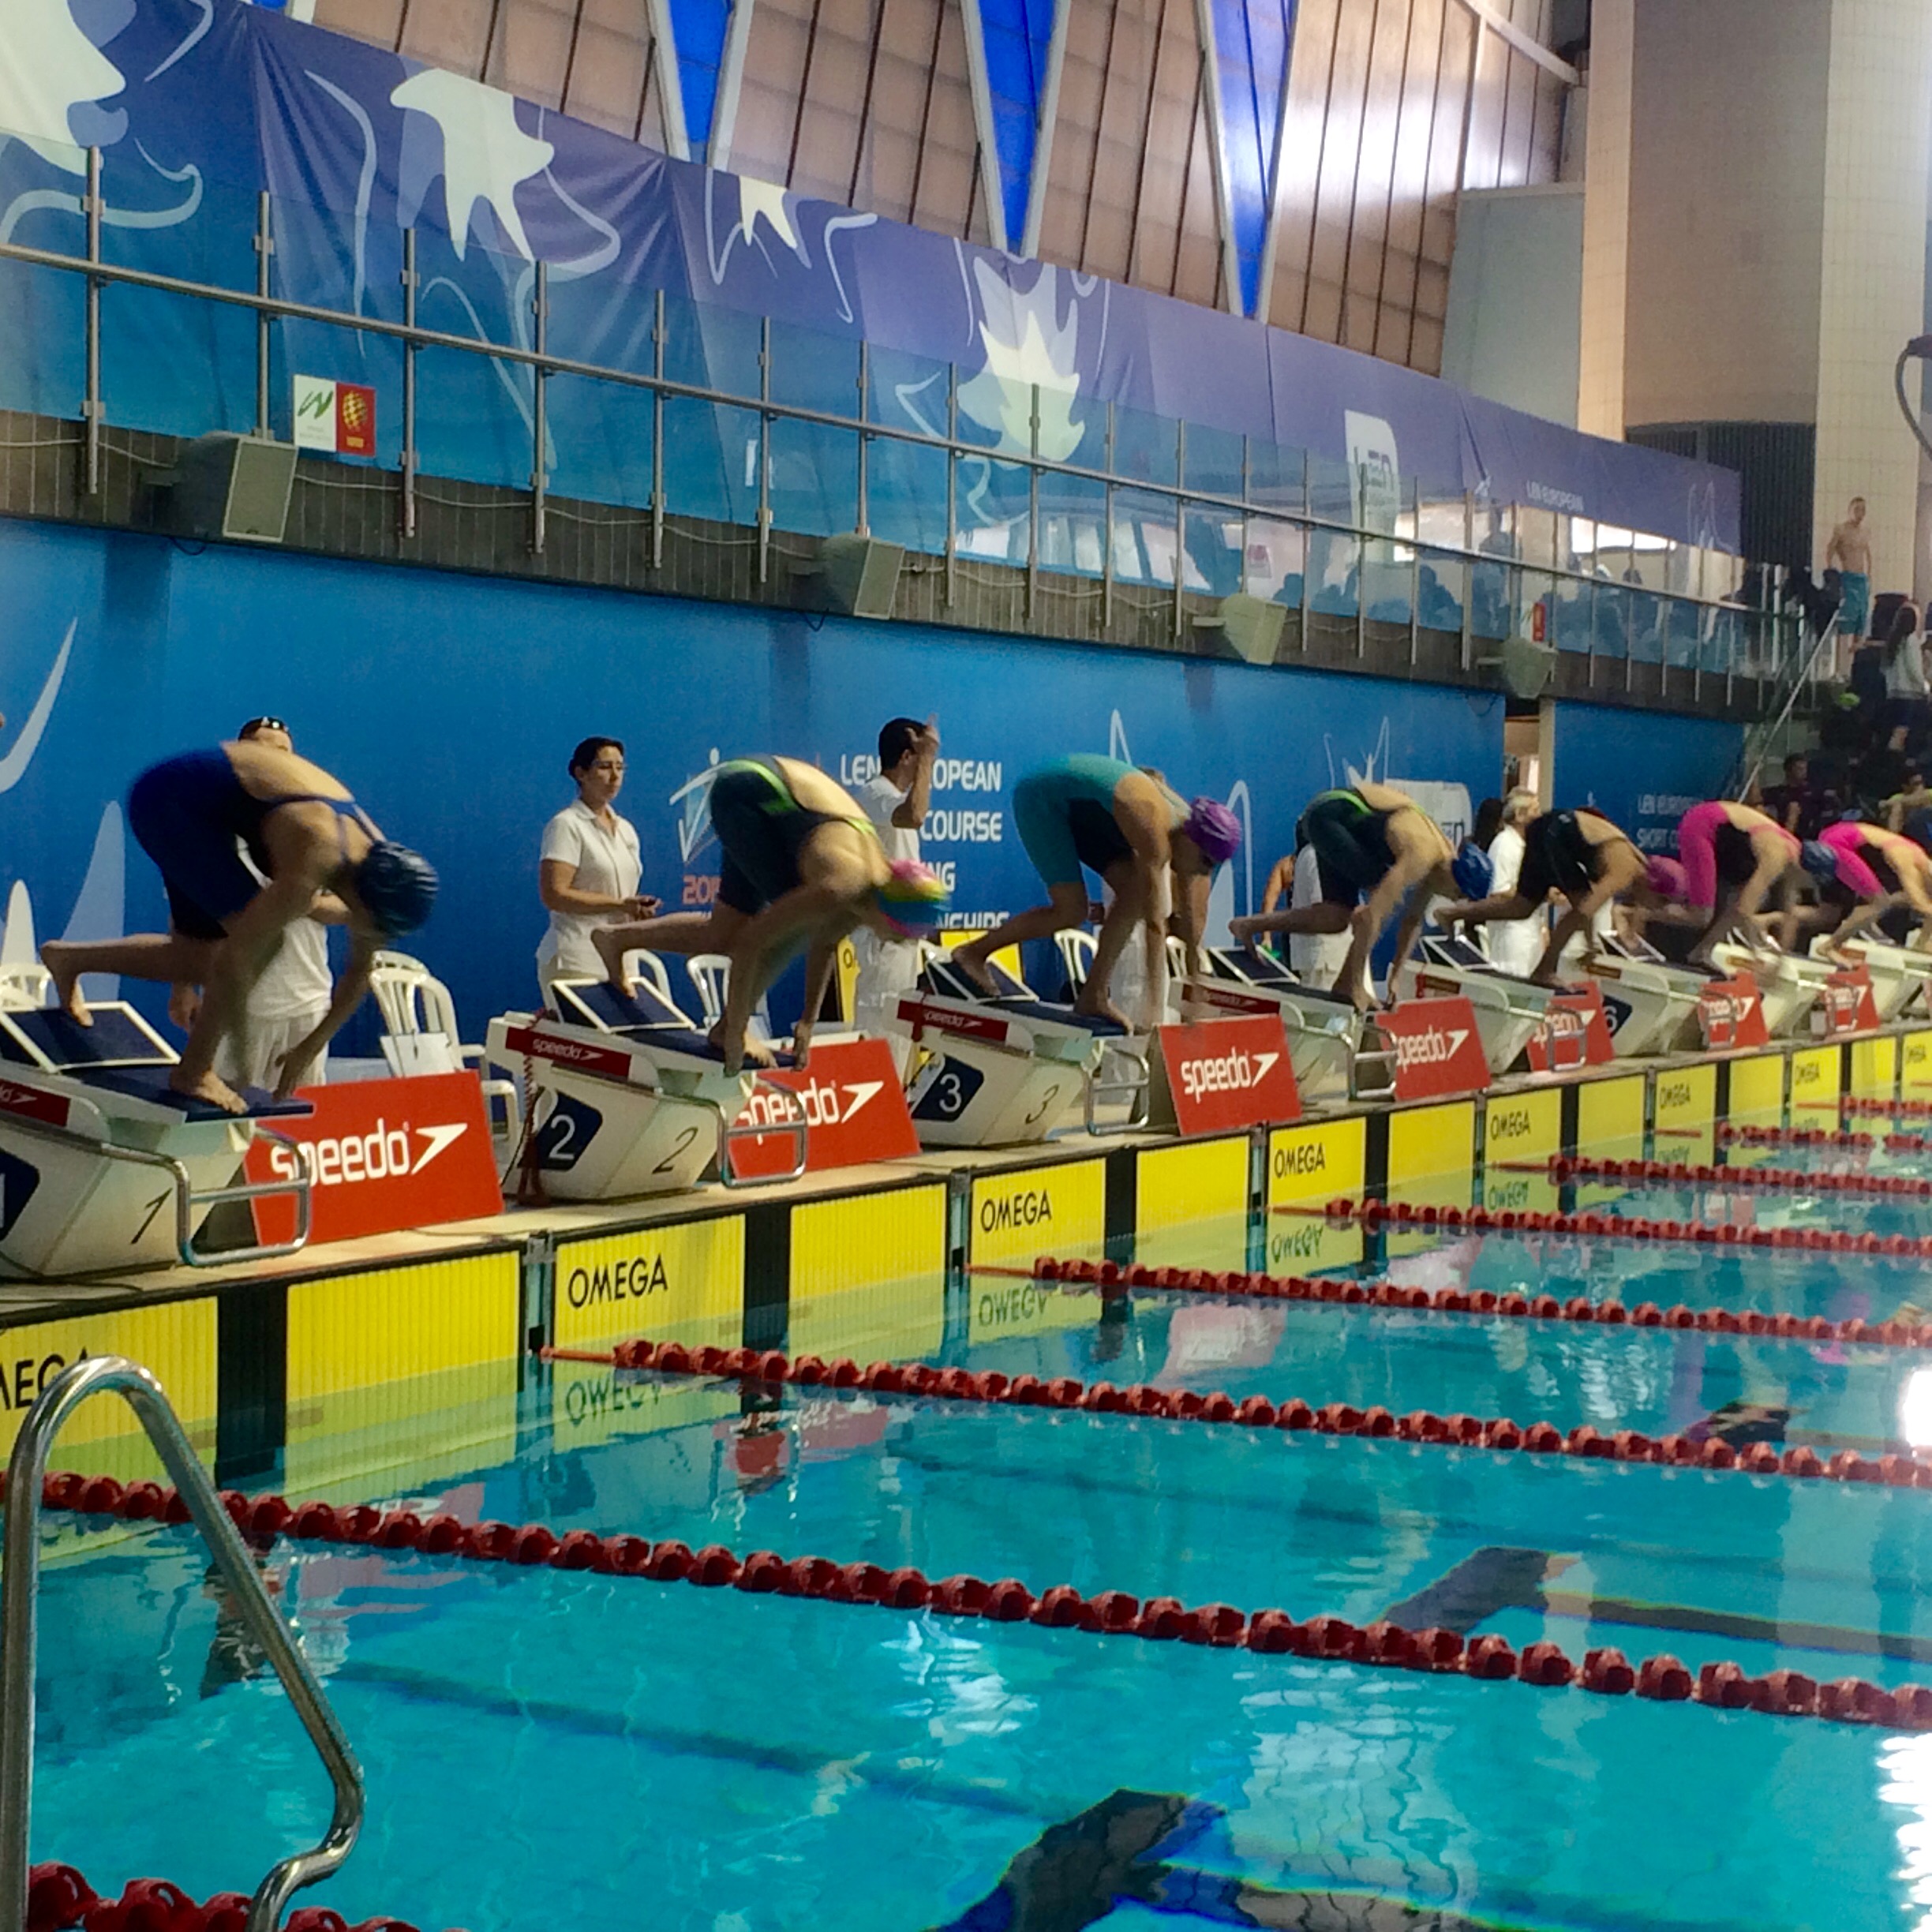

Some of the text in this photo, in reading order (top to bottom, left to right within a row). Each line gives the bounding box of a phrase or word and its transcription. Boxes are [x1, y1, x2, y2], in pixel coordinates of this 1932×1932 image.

[928, 758, 1002, 792] OPEAN
[920, 810, 1002, 842] COURSE
[533, 1038, 582, 1060] speedo
[939, 1073, 962, 1113] 3
[1181, 1046, 1252, 1104] speedo
[1025, 1084, 1059, 1125] 3
[1490, 1109, 1531, 1141] OMEGA
[549, 1114, 575, 1160] 2
[652, 1126, 698, 1174] 2
[1274, 1142, 1326, 1179] OMEGA
[131, 1187, 173, 1245] 1
[980, 1189, 1052, 1233] OMEGA
[568, 1253, 668, 1309] OMEGA
